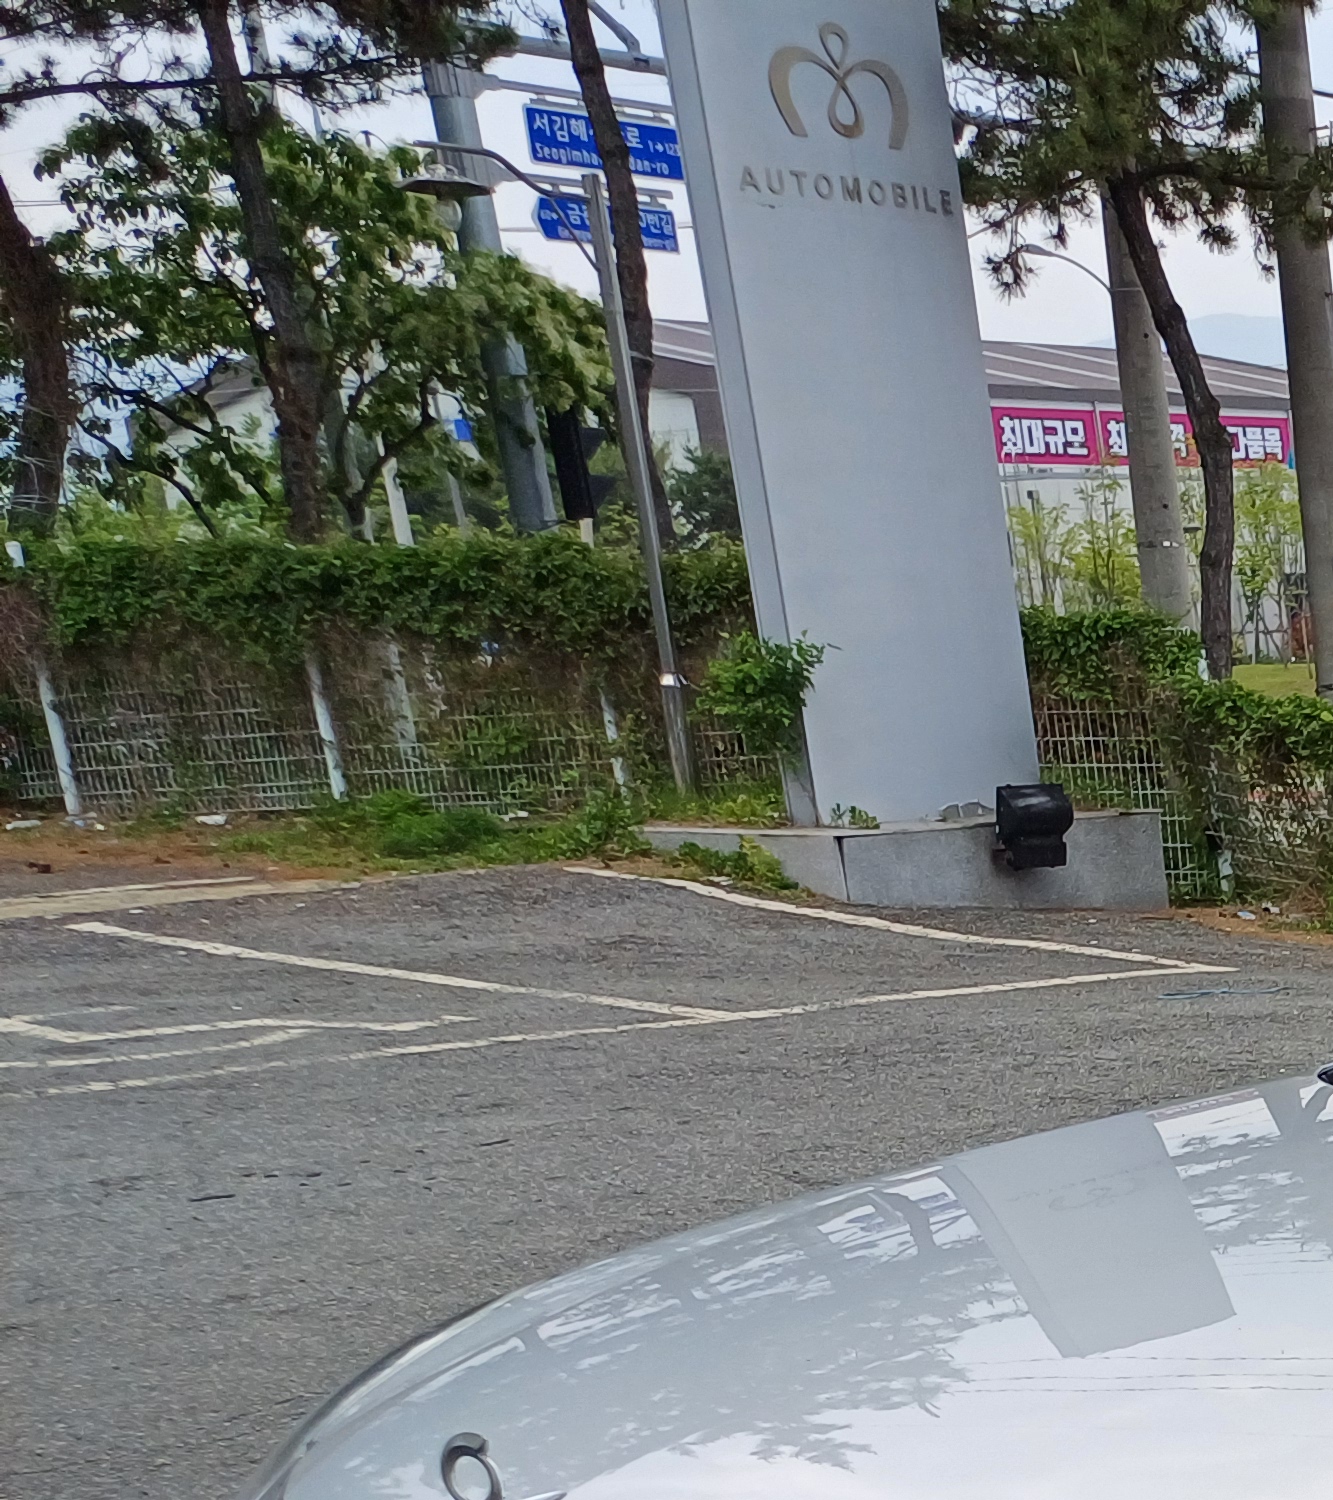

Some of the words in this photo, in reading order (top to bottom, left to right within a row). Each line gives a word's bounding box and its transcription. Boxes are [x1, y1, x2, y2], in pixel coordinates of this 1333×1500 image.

[533, 112, 643, 149] 서김해로
[740, 165, 954, 217] AUTOMOBILE
[999, 416, 1089, 456] 최대규모
